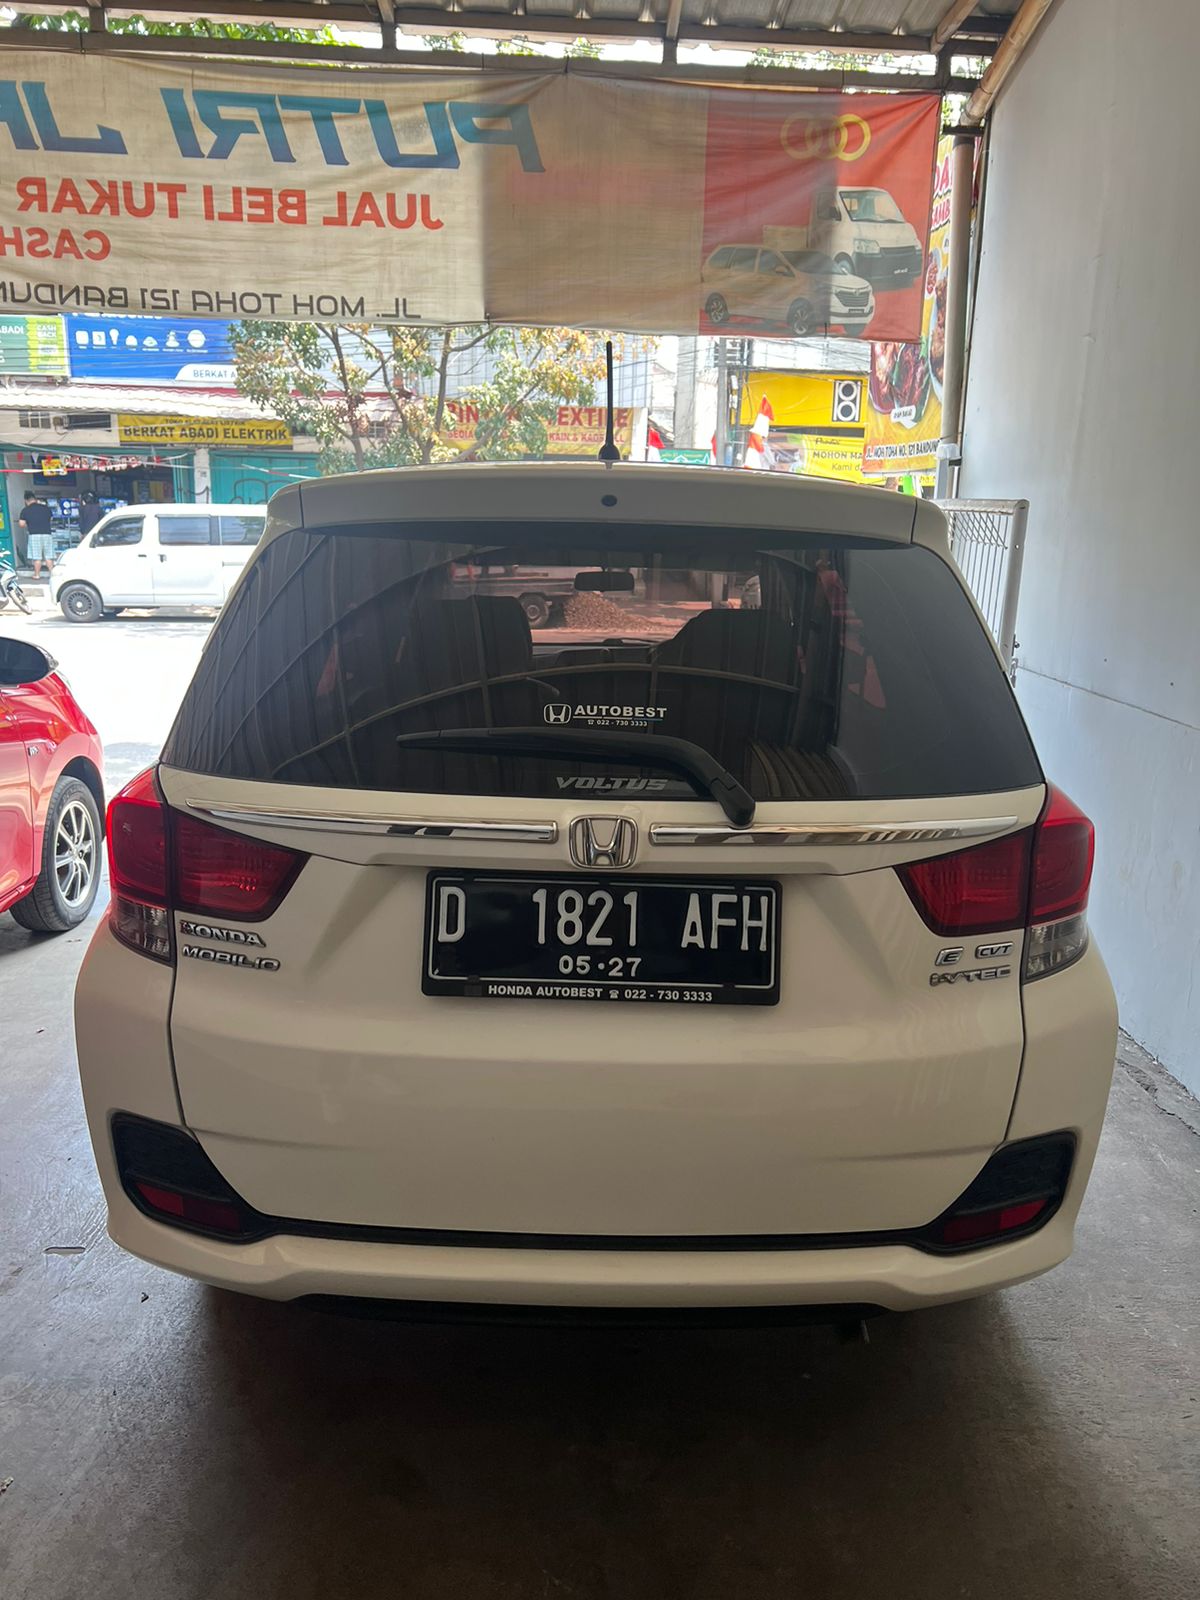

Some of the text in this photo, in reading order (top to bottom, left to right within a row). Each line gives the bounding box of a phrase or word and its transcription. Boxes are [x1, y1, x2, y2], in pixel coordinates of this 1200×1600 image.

[193, 369, 228, 379] BERKAT
[124, 426, 288, 441] BERKAT ABADI ELEKTRIK
[813, 450, 848, 460] MOHON
[916, 440, 940, 455] BANDUN
[831, 463, 853, 472] Kami
[574, 704, 668, 718] AUTOBEST
[556, 776, 668, 791] VOLTUS
[437, 886, 769, 952] D 1821 AFH
[180, 920, 266, 948] HONDA
[182, 944, 281, 971] MOBILIO
[978, 943, 1014, 957] CVT
[488, 985, 533, 996] HONDA
[536, 985, 603, 998] AUTOBEST
[624, 988, 647, 999] 022
[657, 990, 680, 1000] 730
[682, 990, 713, 1001] 3333
